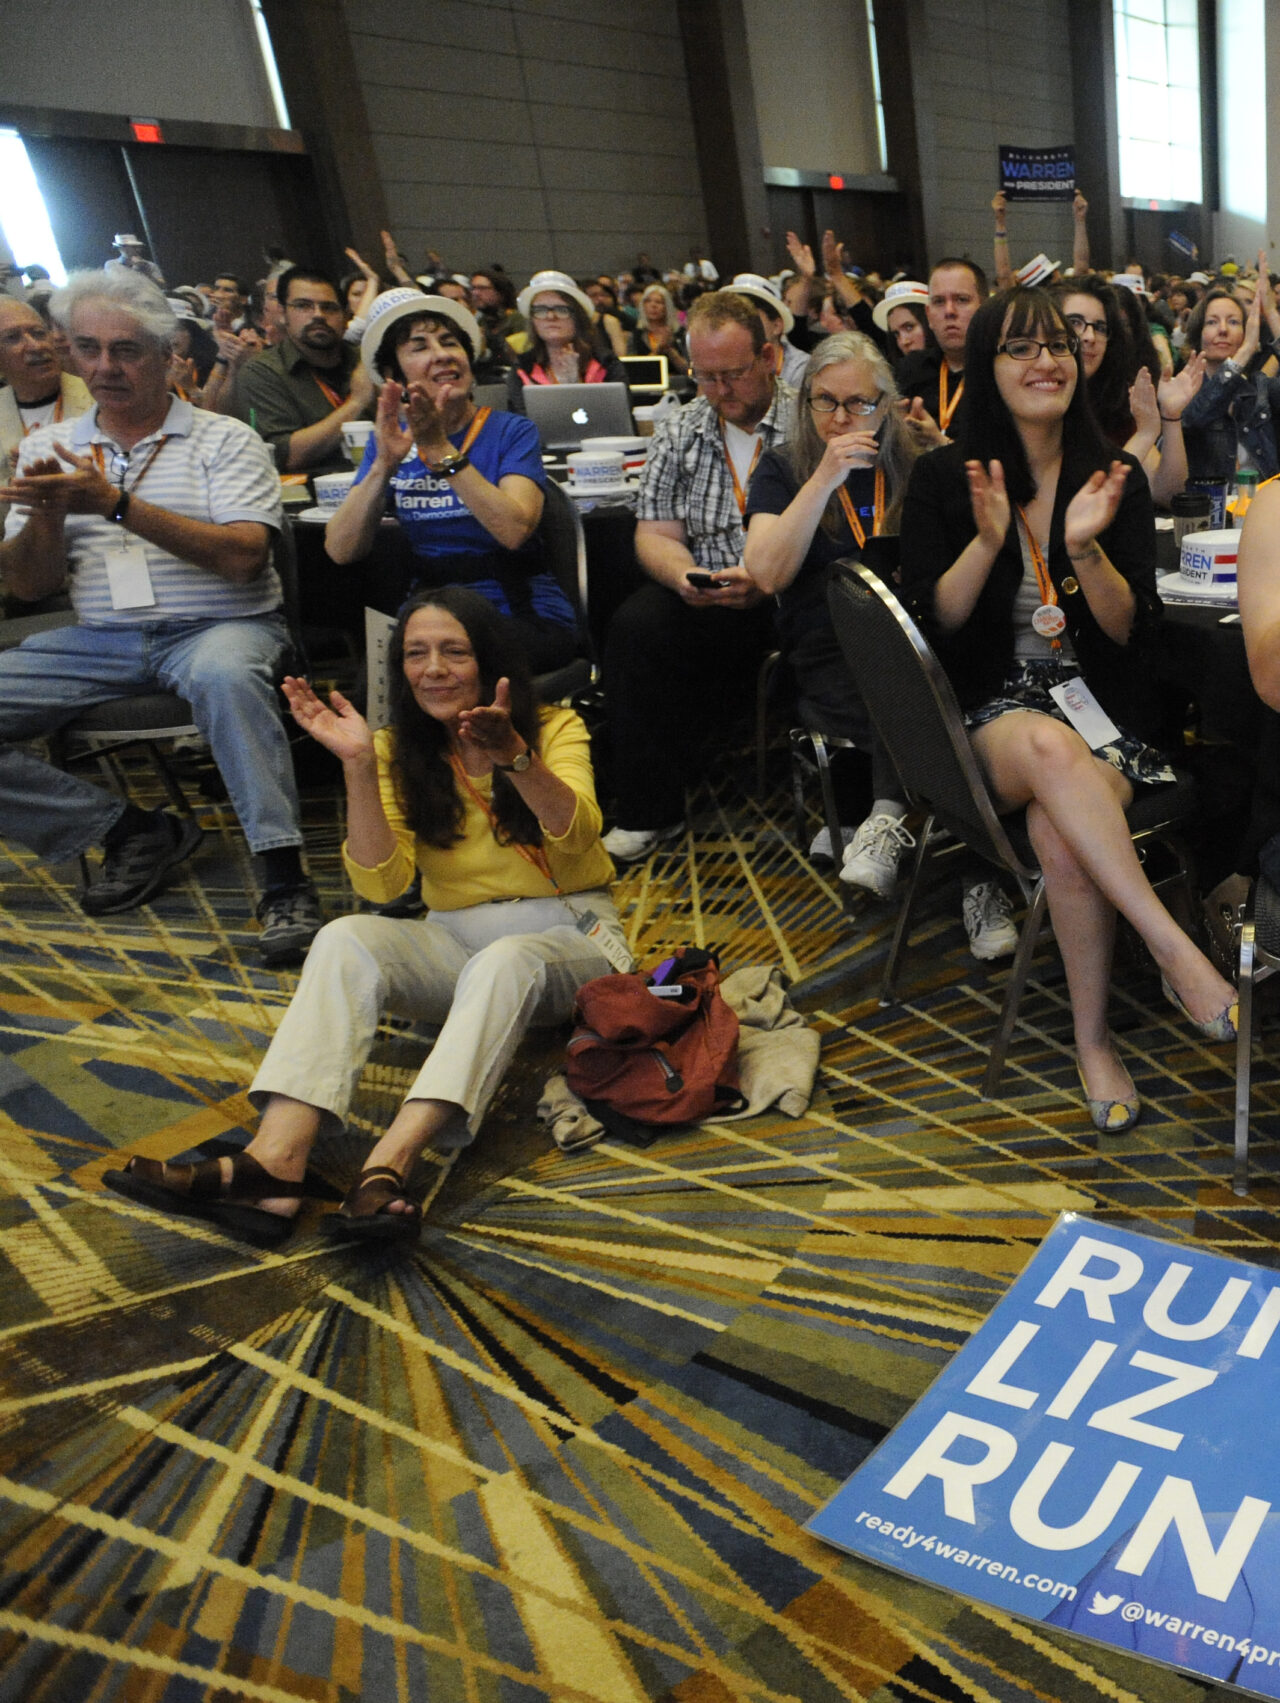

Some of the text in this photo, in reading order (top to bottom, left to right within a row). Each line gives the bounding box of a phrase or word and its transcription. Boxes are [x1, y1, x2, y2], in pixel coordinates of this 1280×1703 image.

[1002, 160, 1075, 178] WARREN
[1016, 180, 1075, 190] PRESIDENT
[964, 1320, 1219, 1451] LIZ
[882, 1410, 1271, 1603] RUN
[854, 1507, 1078, 1601] ready4warren.com
